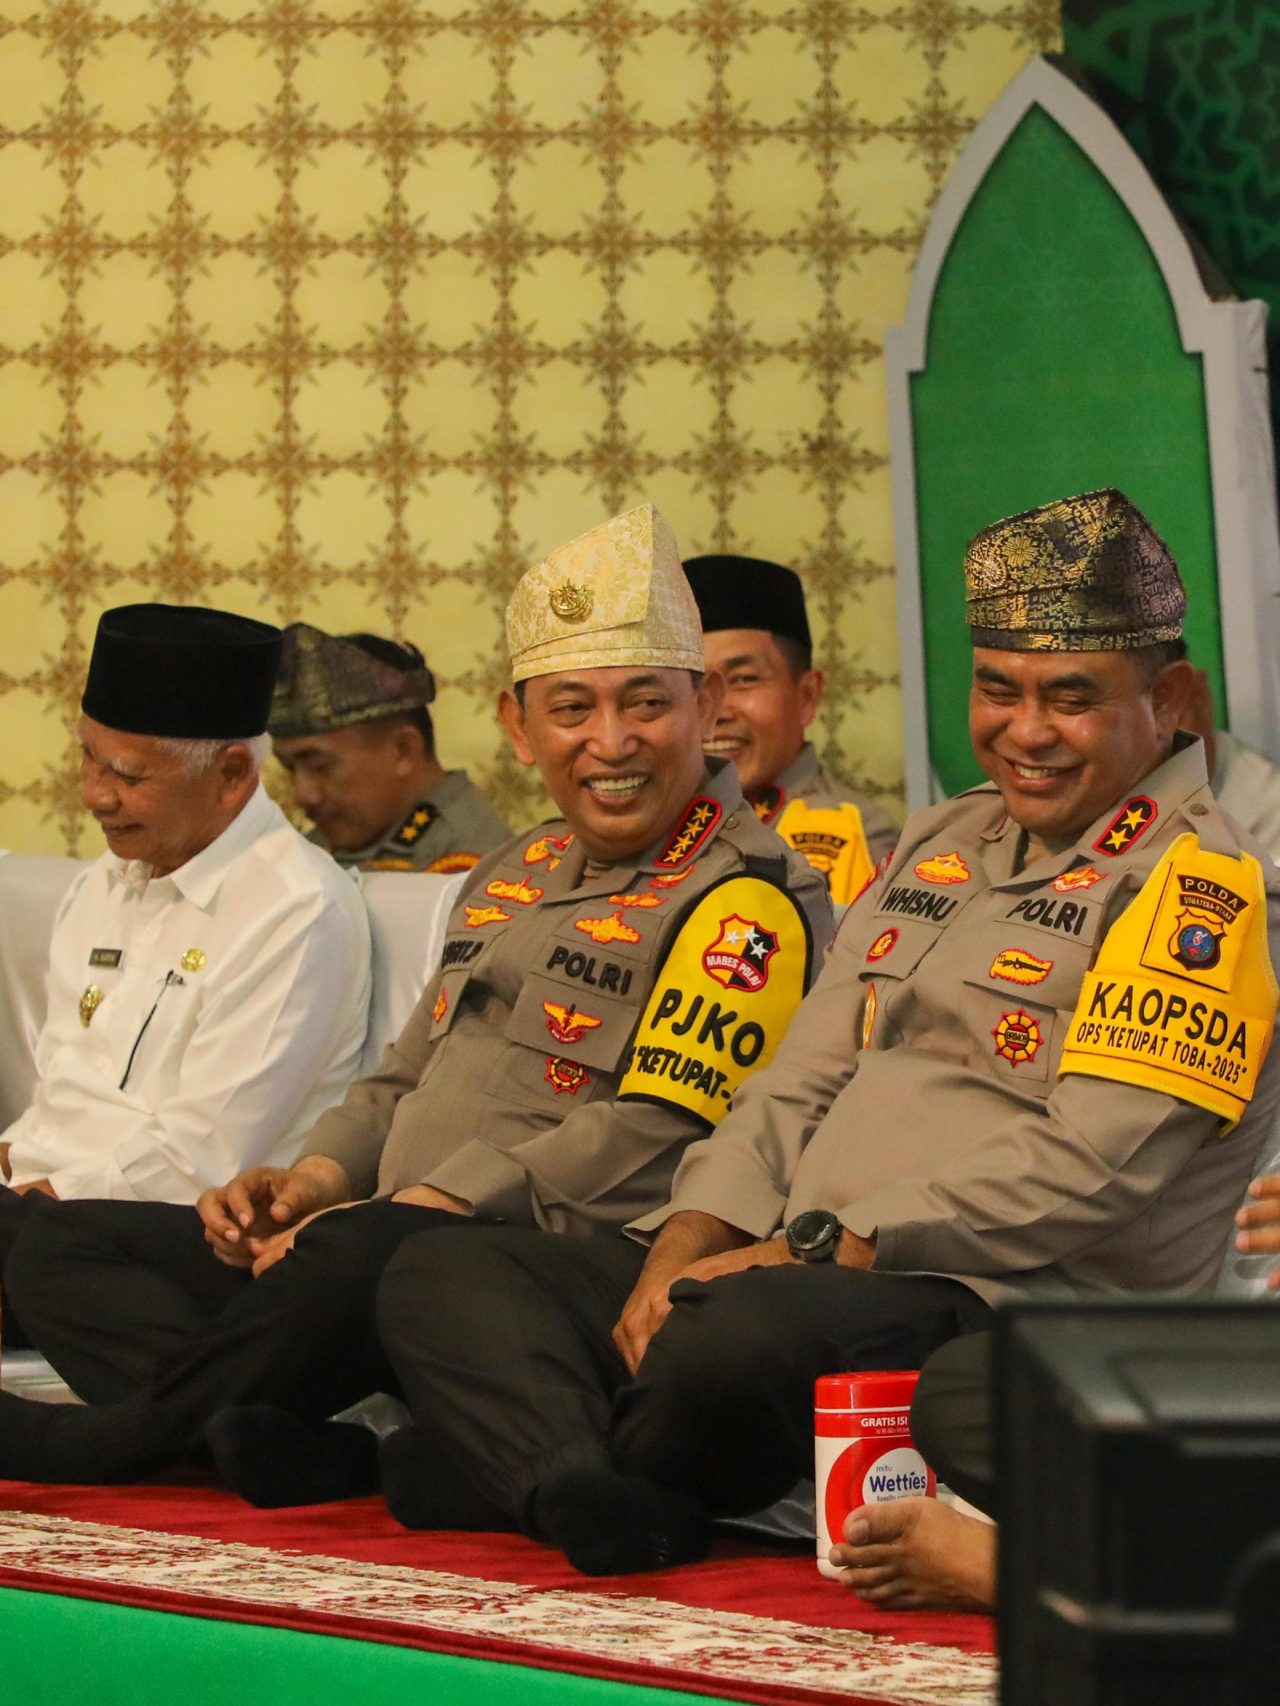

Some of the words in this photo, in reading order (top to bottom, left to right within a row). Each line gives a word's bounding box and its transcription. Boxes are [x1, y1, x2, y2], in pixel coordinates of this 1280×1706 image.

[881, 887, 958, 922] WHISNU
[1184, 878, 1238, 909] POLDA
[1005, 898, 1088, 936] POLRI
[546, 946, 633, 996] POLRI
[706, 954, 738, 970] MABES
[738, 962, 761, 987] POLRI
[650, 988, 765, 1067] PJKO
[1088, 981, 1248, 1060] KAOPSDA
[1077, 1022, 1102, 1045] OPS
[1105, 1025, 1169, 1057] "KETUPAT
[1172, 1041, 1248, 1085] TOBA-2025"
[861, 1417, 896, 1428] GRATIS
[897, 1416, 908, 1426] ISI
[869, 1472, 926, 1493] Wetties
